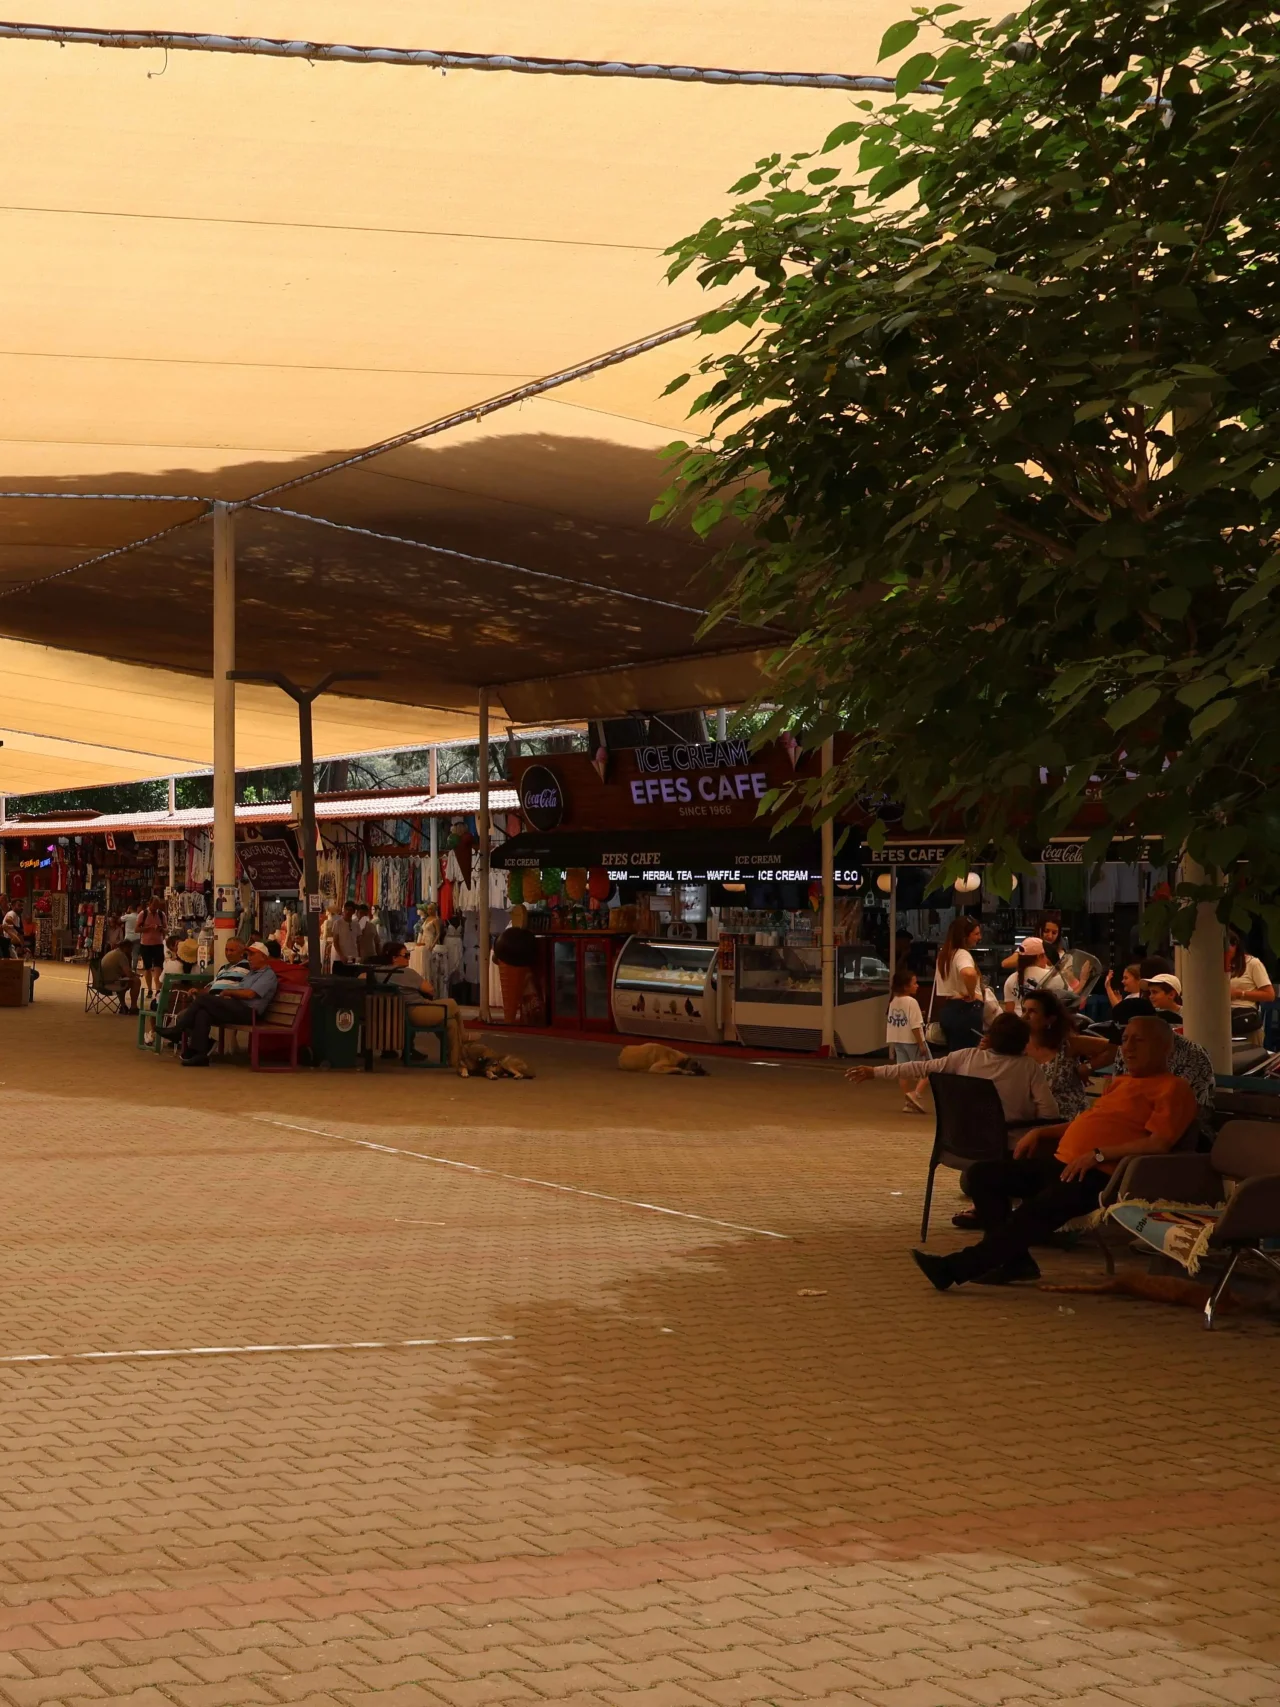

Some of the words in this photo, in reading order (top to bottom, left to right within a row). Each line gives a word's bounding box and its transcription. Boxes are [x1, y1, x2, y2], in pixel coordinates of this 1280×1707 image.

[634, 746, 671, 773] ICE
[673, 740, 749, 770] CREAM
[629, 777, 692, 805] EFES
[698, 772, 768, 802] CAFE
[679, 806, 708, 817] SINCE
[710, 805, 732, 816] 1966
[601, 853, 628, 865] EFES
[630, 852, 661, 864] CAFE
[734, 855, 751, 865] ICE
[753, 854, 782, 865] CREAM
[872, 849, 906, 862] EFES
[908, 848, 945, 861] CAFE
[517, 858, 540, 867] CREAM
[642, 870, 673, 881] HERBAL
[676, 870, 693, 881] TEA
[707, 869, 740, 880] WAFFLE
[757, 870, 773, 881] ICE
[774, 870, 808, 881] CREAM
